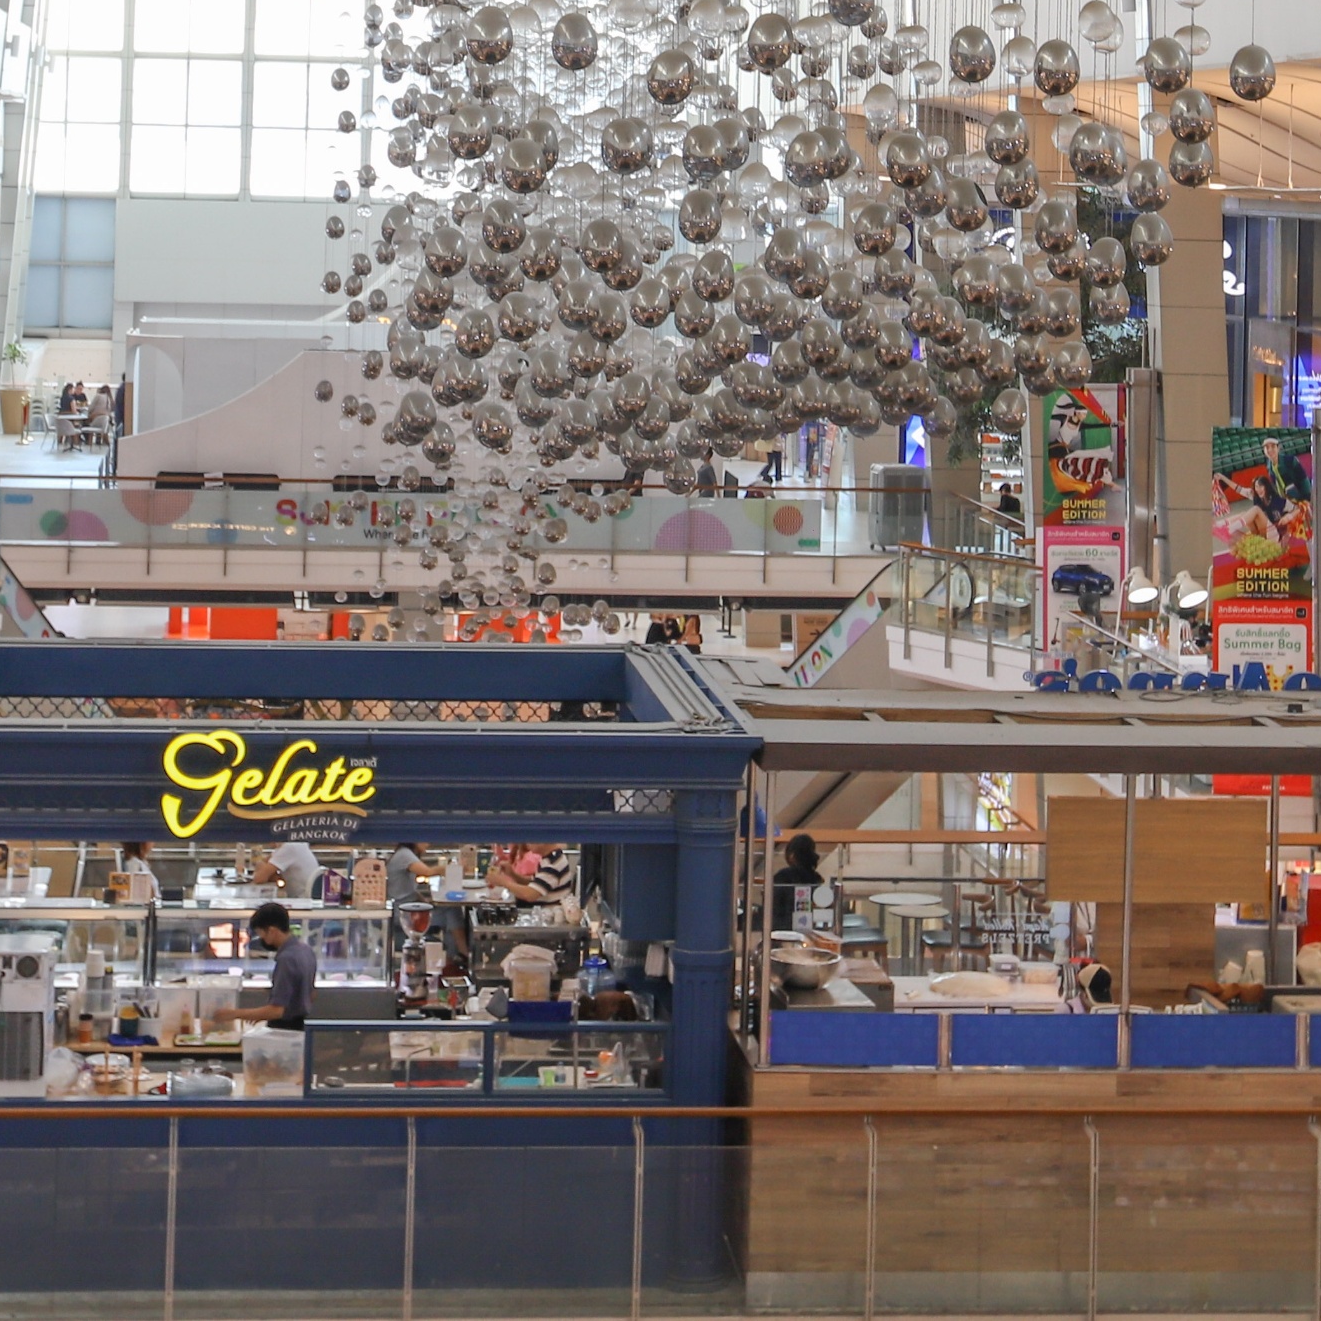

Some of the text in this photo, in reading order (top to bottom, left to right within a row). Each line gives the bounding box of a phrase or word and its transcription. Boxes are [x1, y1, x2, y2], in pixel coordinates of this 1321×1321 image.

[1062, 499, 1106, 509] SUMMER
[1062, 510, 1106, 520] EDITION
[1085, 548, 1099, 557] 60
[1237, 568, 1289, 579] SUMMER
[1237, 581, 1289, 592] EDITION
[1224, 638, 1301, 652] Summer Bag
[161, 730, 376, 838] Gelate
[273, 817, 358, 832] GELATERIA DI
[290, 831, 348, 842] BANGKOK
